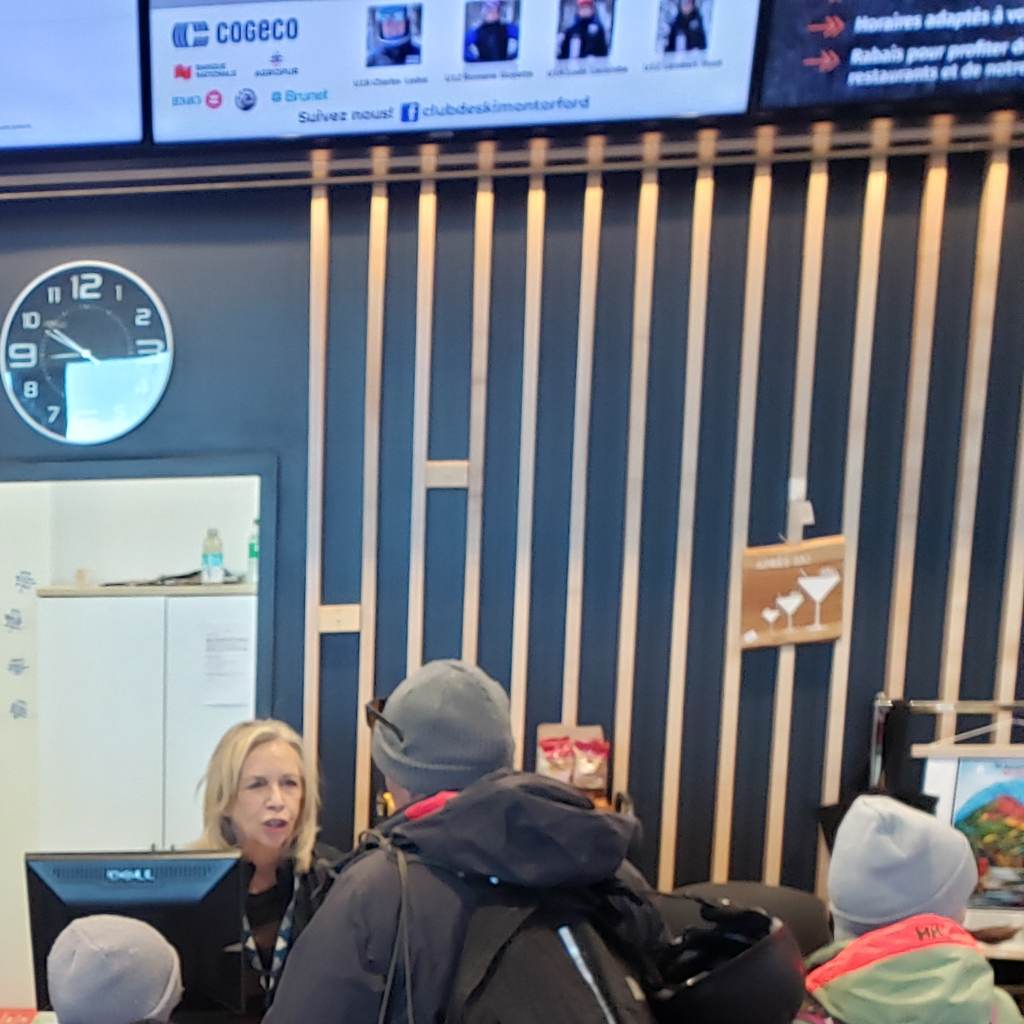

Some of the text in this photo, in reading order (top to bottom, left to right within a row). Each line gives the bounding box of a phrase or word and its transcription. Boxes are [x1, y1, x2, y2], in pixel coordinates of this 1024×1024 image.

[853, 11, 922, 34] Horaires
[924, 6, 991, 31] adaptés
[849, 43, 904, 66] Rabais
[905, 45, 946, 65] pour
[298, 108, 347, 123] Suivez
[48, 286, 62, 304] 11
[70, 272, 104, 300] 12
[115, 284, 123, 302] 1
[22, 311, 41, 329] 10
[134, 308, 152, 326] 2
[8, 342, 38, 368] 9
[23, 381, 39, 399] 8
[47, 405, 61, 424] 7
[106, 869, 156, 881] DELL
